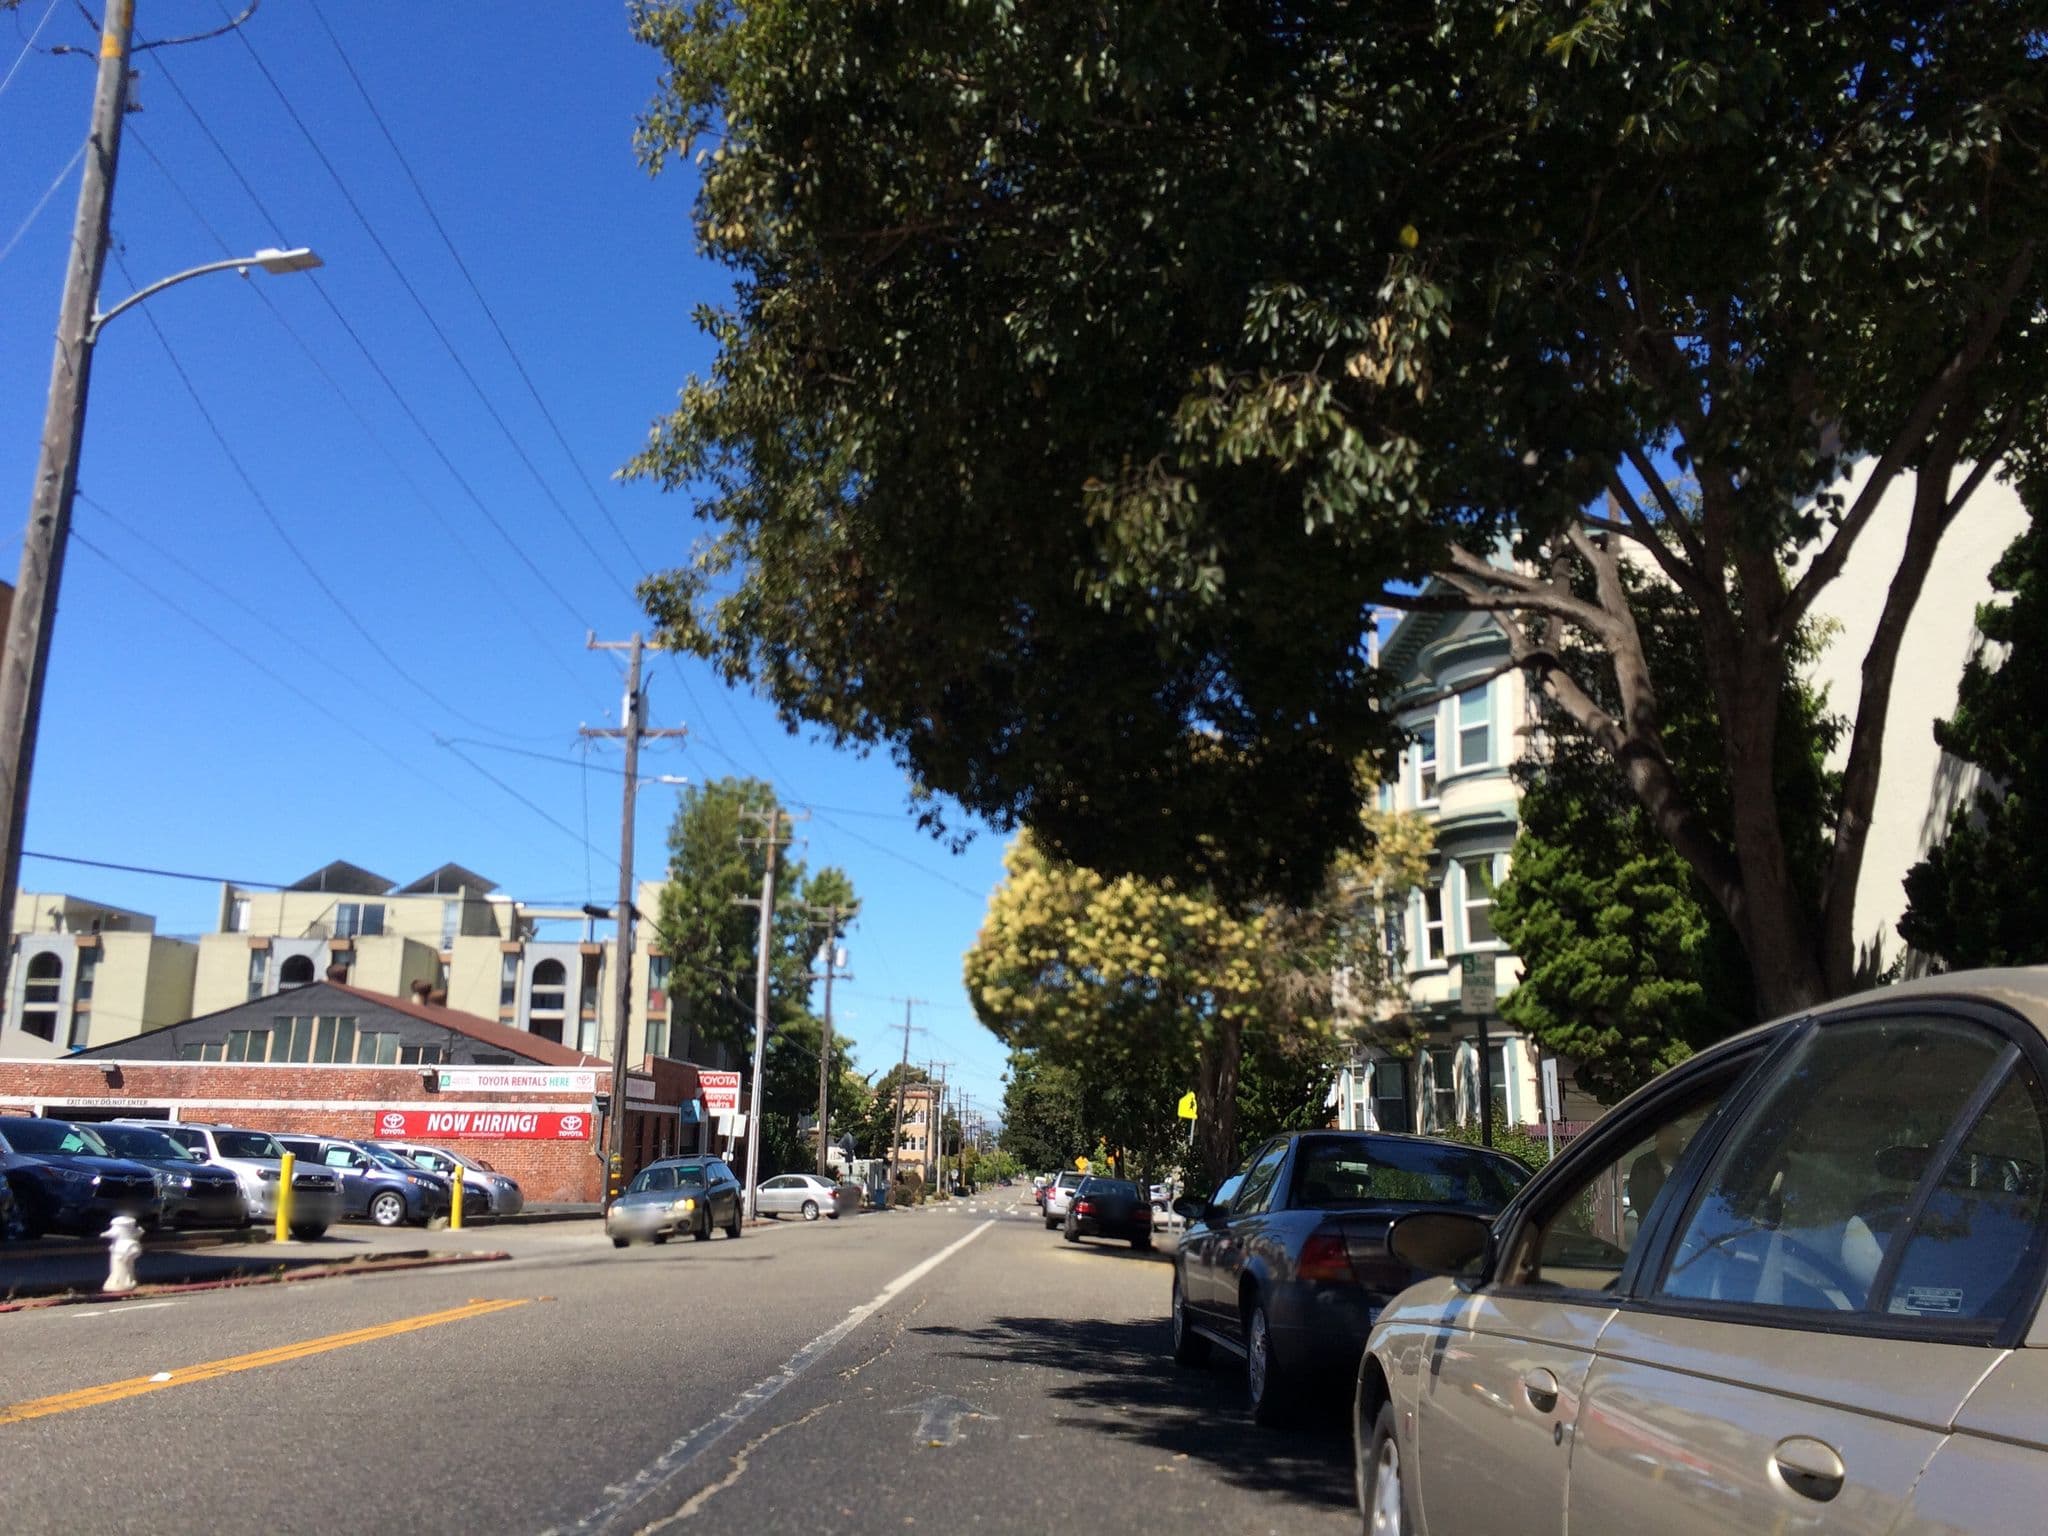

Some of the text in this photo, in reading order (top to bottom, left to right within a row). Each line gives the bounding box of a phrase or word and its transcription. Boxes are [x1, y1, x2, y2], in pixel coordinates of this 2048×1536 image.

[478, 1076, 509, 1087] TOYOTA
[511, 1076, 547, 1087] RENTALS
[549, 1077, 569, 1087] HERE
[699, 1075, 737, 1086] TOYOTA
[427, 1113, 538, 1133] NOW HIRING!
